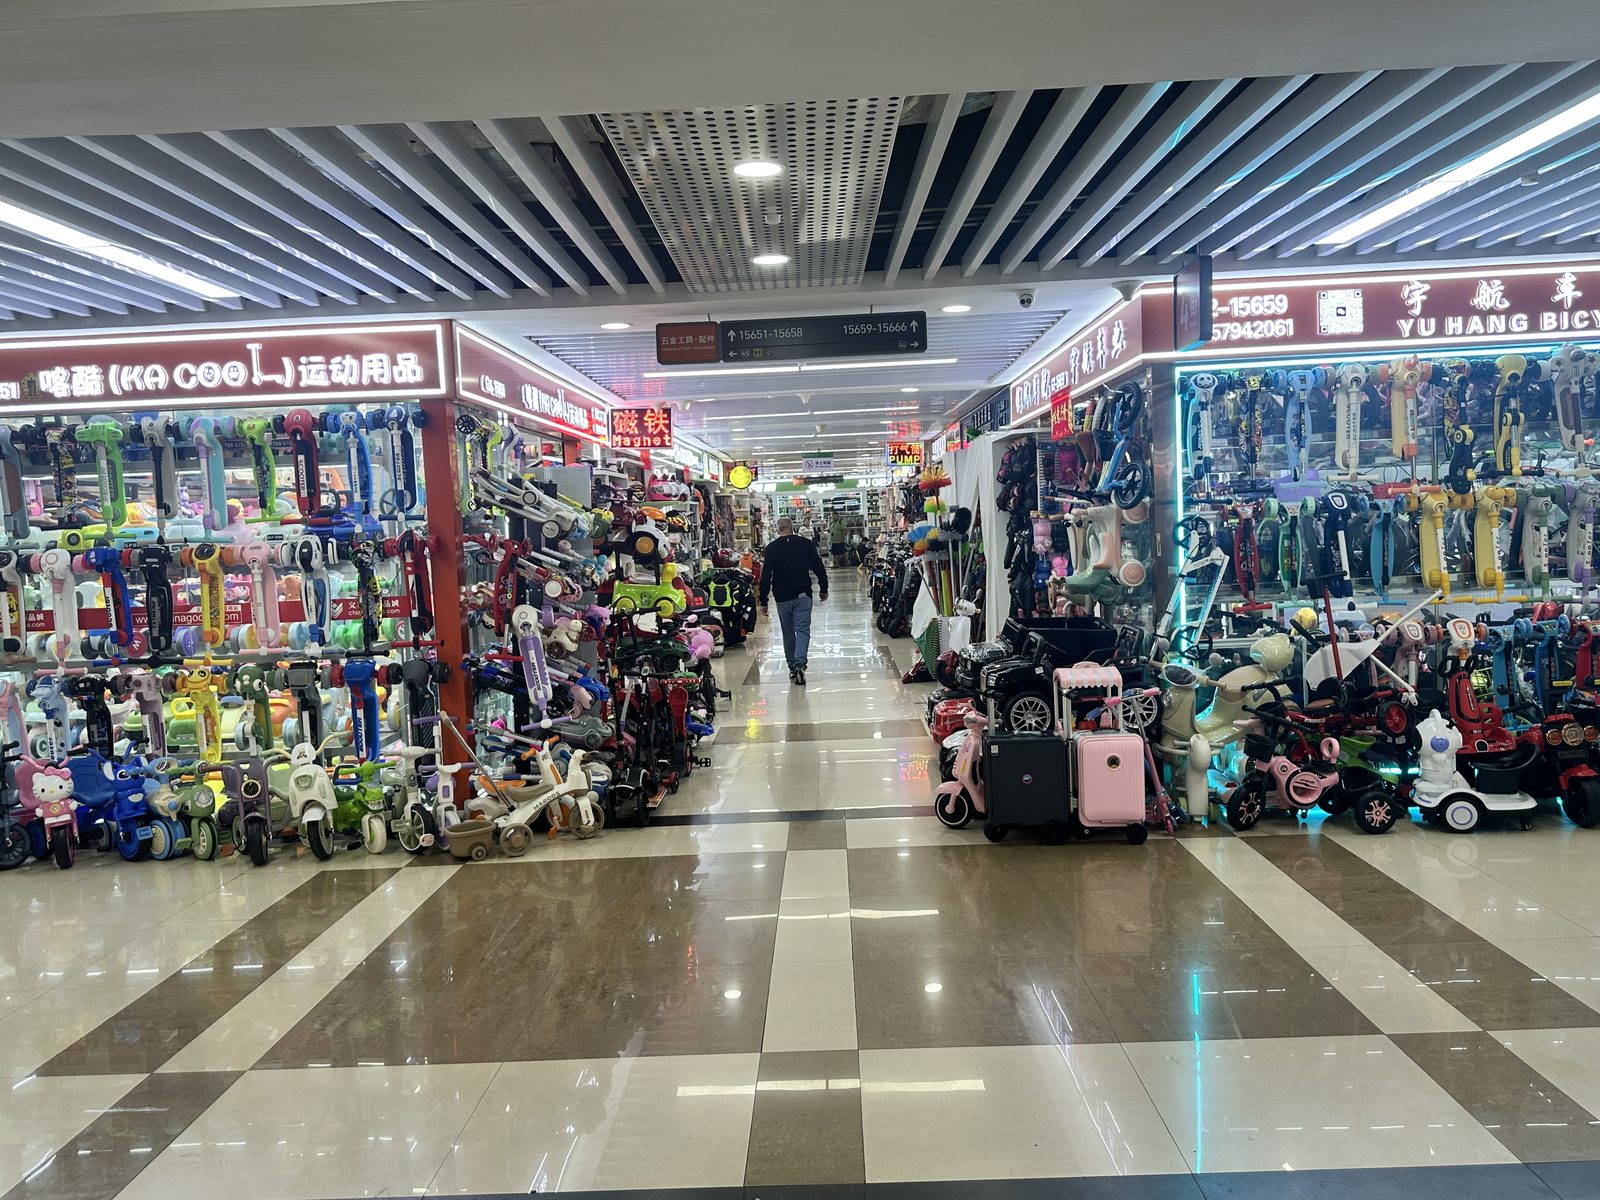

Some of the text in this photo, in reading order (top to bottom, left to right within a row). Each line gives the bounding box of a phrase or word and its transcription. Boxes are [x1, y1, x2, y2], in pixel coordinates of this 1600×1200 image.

[843, 321, 908, 335] 15659-15666
[1397, 318, 1436, 338] YU
[1445, 313, 1529, 336] HANG
[661, 334, 715, 345] 五金工具-配件
[739, 327, 803, 340] 15651-15658
[297, 353, 424, 386] 运动用品
[612, 409, 670, 435] 磁铁
[612, 433, 671, 447] Magnet
[889, 454, 921, 464] PUMP
[531, 661, 541, 691] SCOOTER
